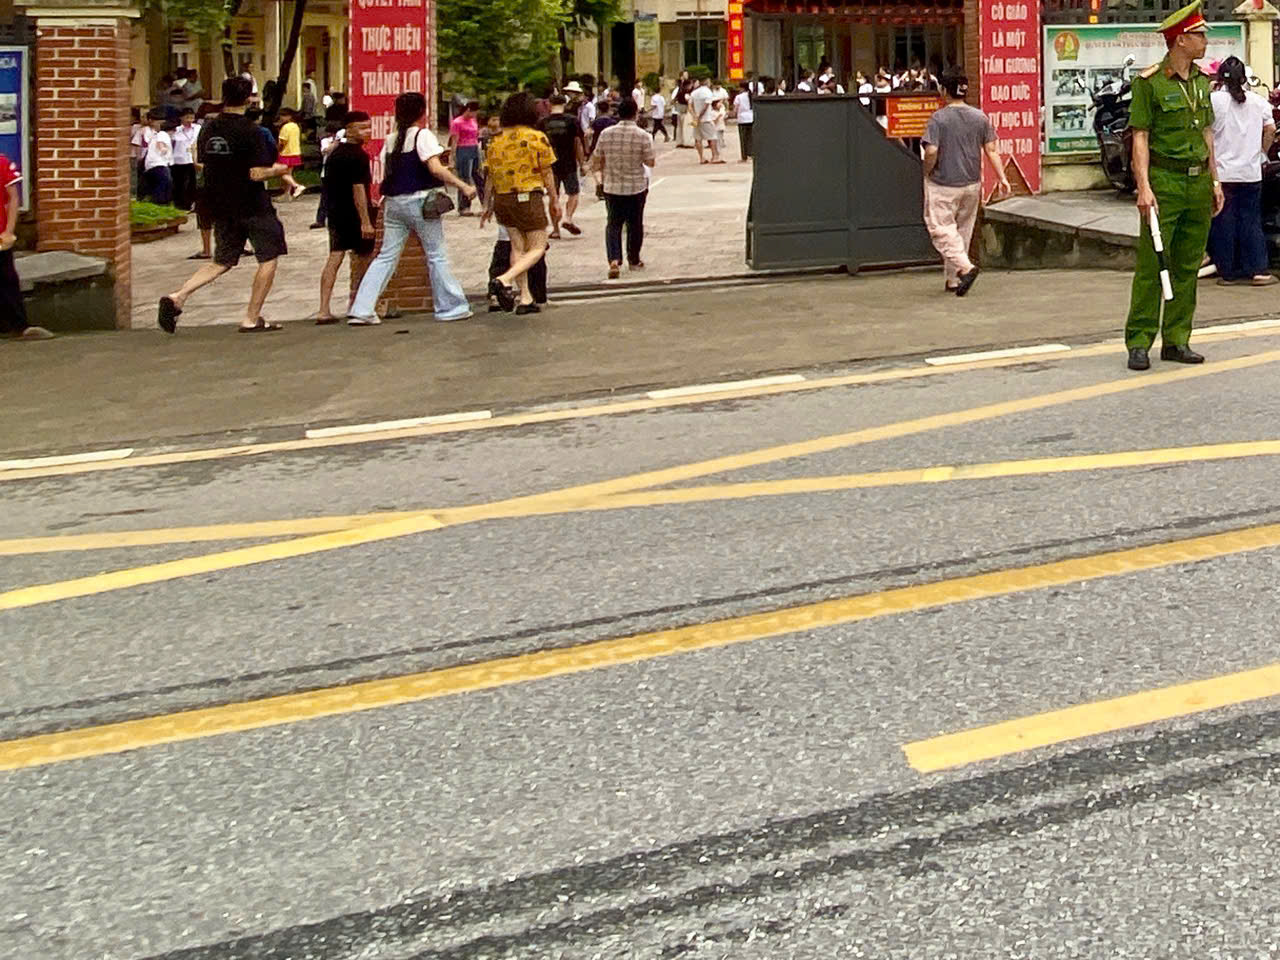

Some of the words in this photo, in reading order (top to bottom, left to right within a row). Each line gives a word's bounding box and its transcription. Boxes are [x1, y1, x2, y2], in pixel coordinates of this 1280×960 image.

[361, 25, 391, 56] THỰC
[394, 23, 421, 55] HIỆN
[992, 29, 1004, 47] LÀ
[1006, 28, 1026, 50] MỘT
[362, 64, 400, 95] THẮNG
